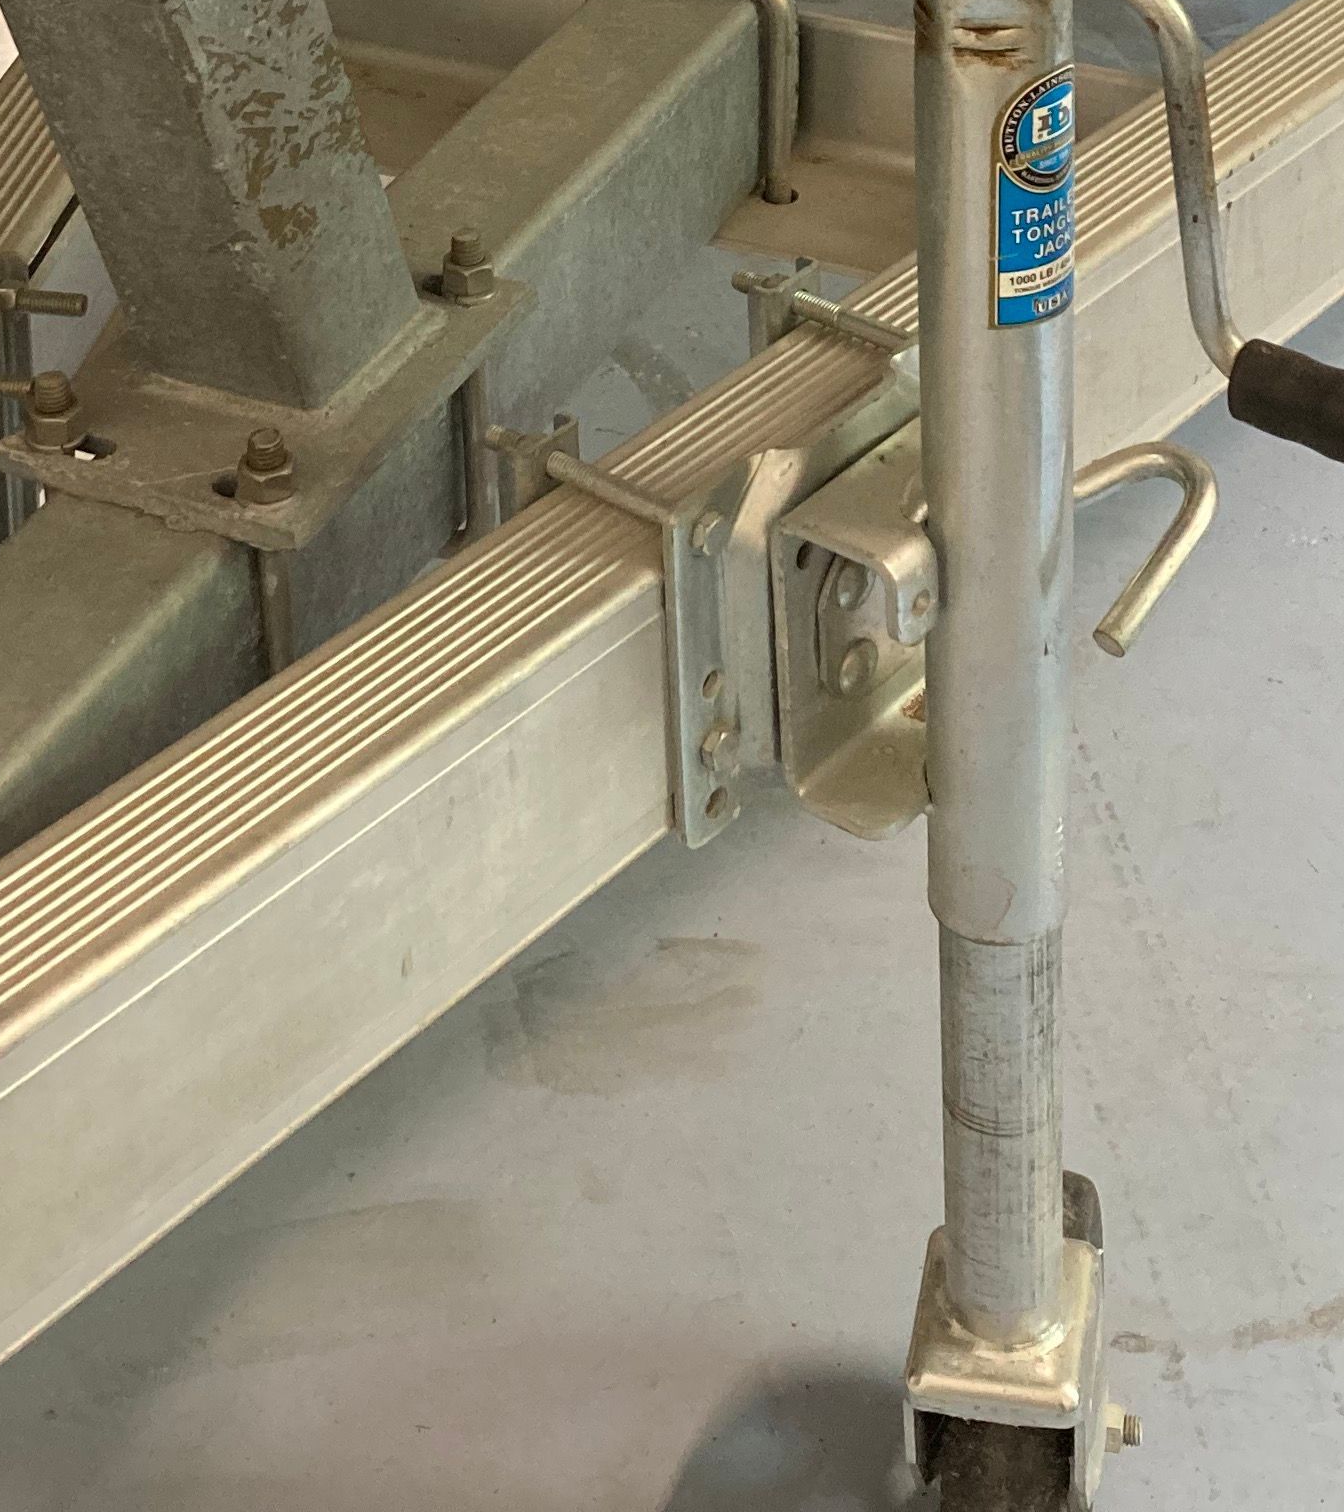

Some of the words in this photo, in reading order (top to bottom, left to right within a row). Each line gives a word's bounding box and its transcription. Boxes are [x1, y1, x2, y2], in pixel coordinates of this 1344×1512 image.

[1034, 230, 1072, 259] JACK
[1009, 273, 1037, 286] 1000
[1040, 267, 1053, 279] LB
